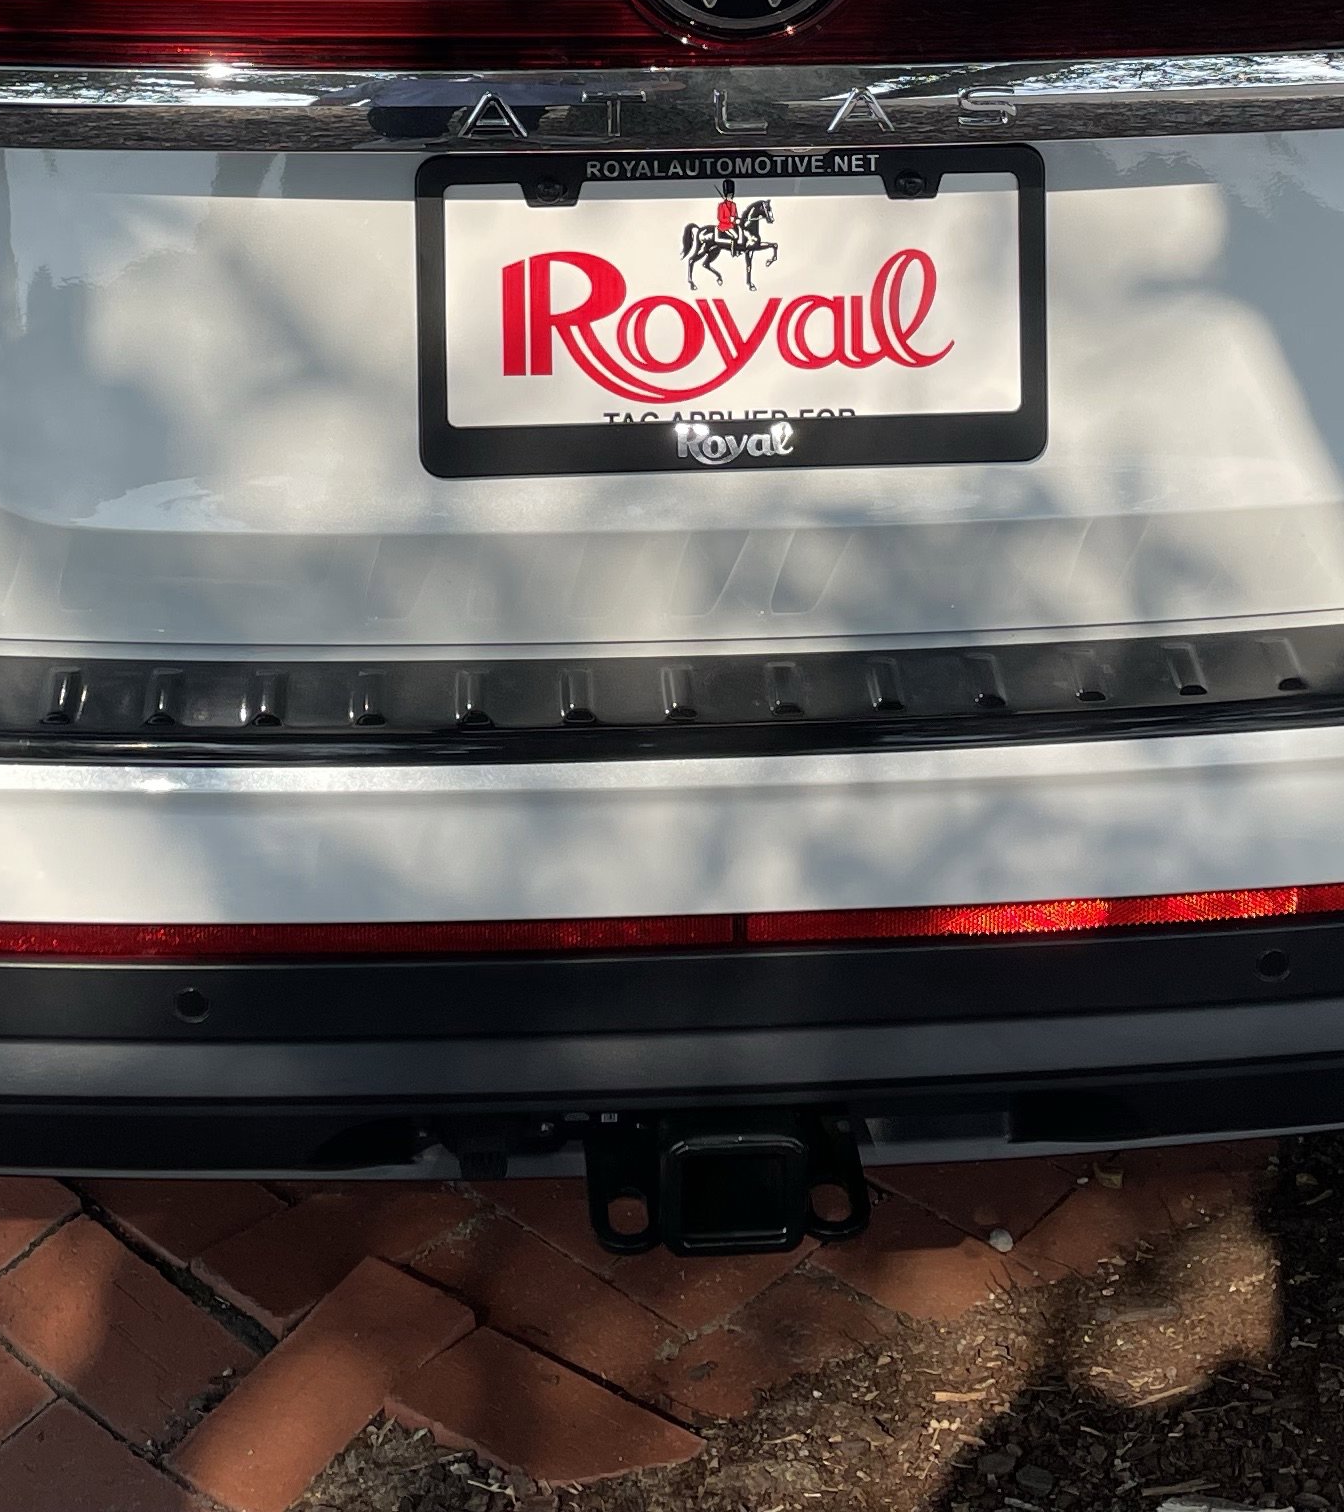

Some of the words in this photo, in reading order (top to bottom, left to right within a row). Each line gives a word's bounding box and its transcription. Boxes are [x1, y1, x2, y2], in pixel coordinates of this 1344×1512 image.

[457, 87, 1017, 138] ATLAS
[586, 154, 880, 178] ROYALAUTOMOTIVE.NET
[502, 248, 955, 404] Royal
[674, 421, 794, 466] Royal
